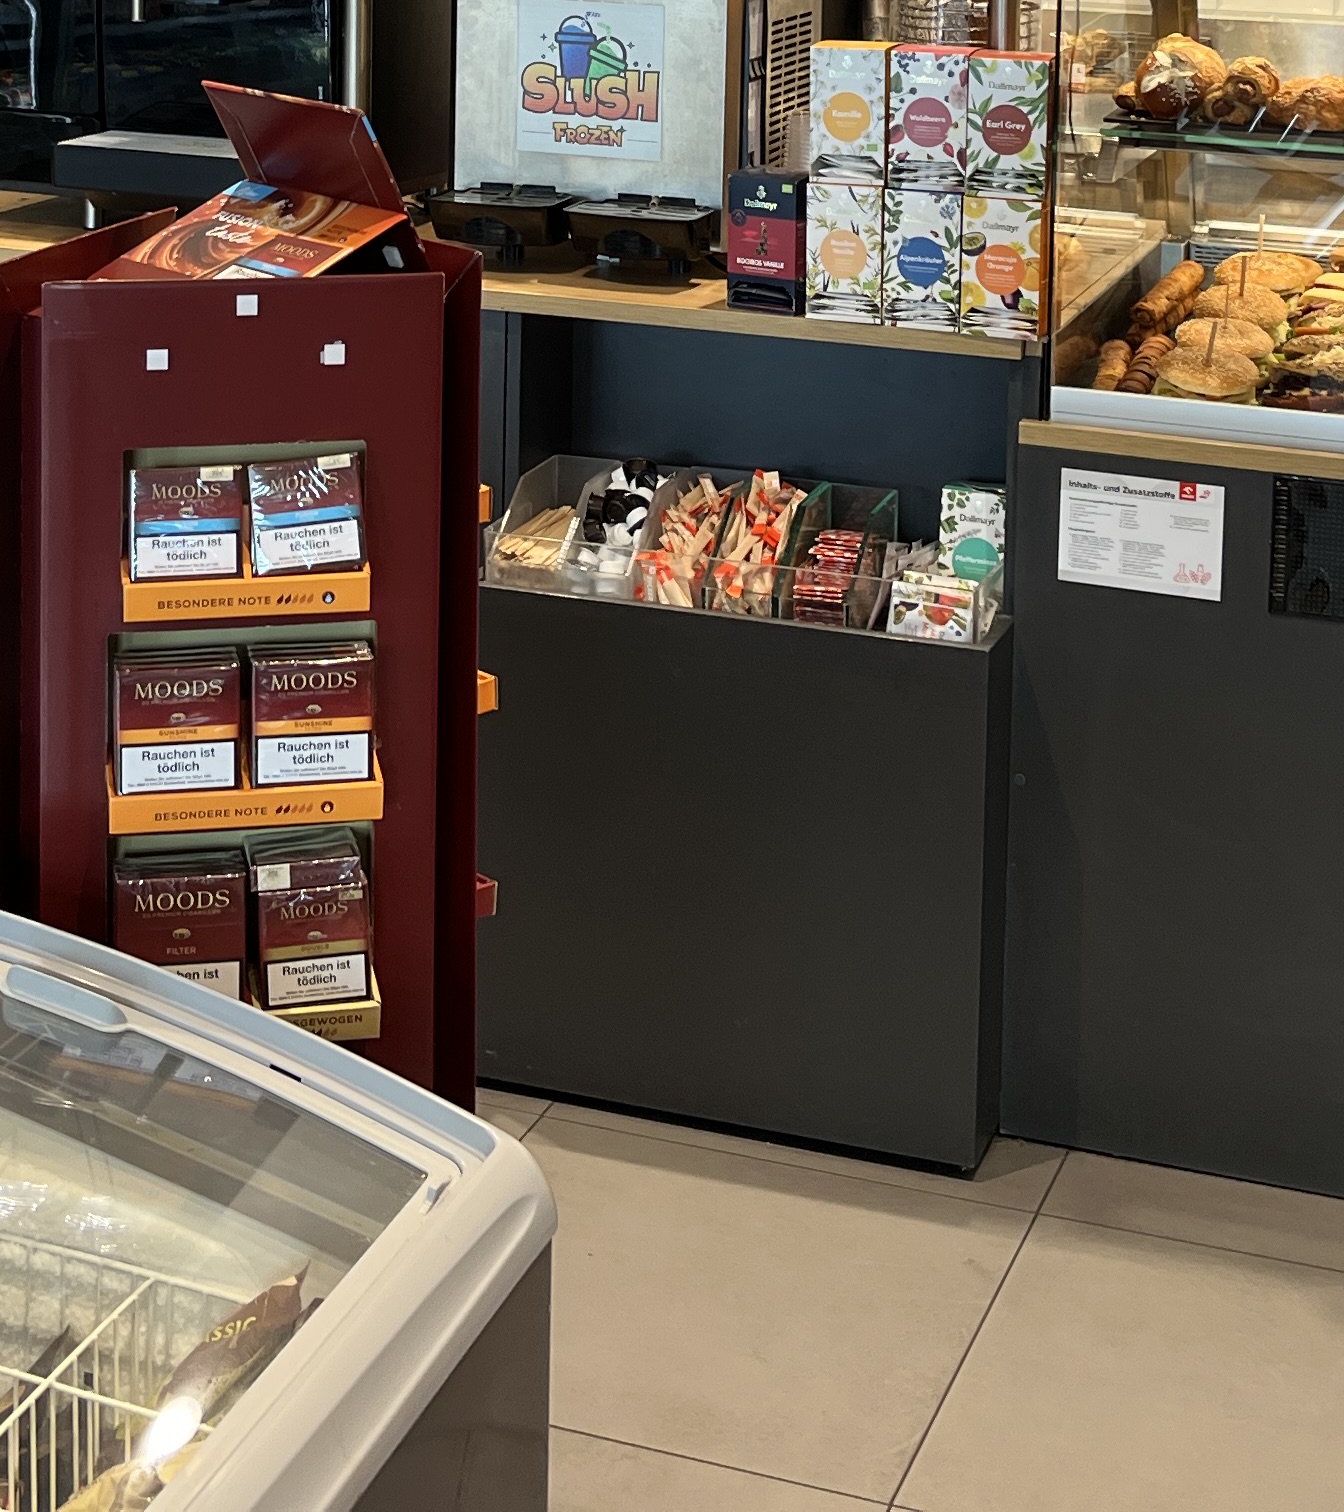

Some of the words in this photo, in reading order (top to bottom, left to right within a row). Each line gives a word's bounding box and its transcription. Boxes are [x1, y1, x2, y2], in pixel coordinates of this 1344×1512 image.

[522, 61, 659, 123] SLUSH
[986, 119, 1003, 130] Earl
[1004, 120, 1027, 133] Grey
[552, 121, 625, 148] FROZEN
[213, 211, 264, 229] FUSION
[1103, 483, 1120, 494] und
[157, 596, 234, 610] BESONDERE
[238, 594, 272, 607] NOTE
[270, 670, 358, 692] MOODS
[134, 678, 224, 701] MOODS
[277, 740, 332, 753] Rauchen
[334, 738, 350, 751] ist
[141, 748, 197, 762] Rauchen
[200, 747, 216, 759] ist
[292, 751, 335, 765] tödlich
[157, 760, 200, 774] tödlich
[154, 808, 231, 822] BESONDERE
[235, 806, 268, 817] NOTE
[134, 889, 231, 913] MOODS
[166, 946, 197, 956] FILTER
[282, 961, 334, 977] Rauchen
[336, 959, 351, 971] ist
[297, 973, 337, 987] tödlich
